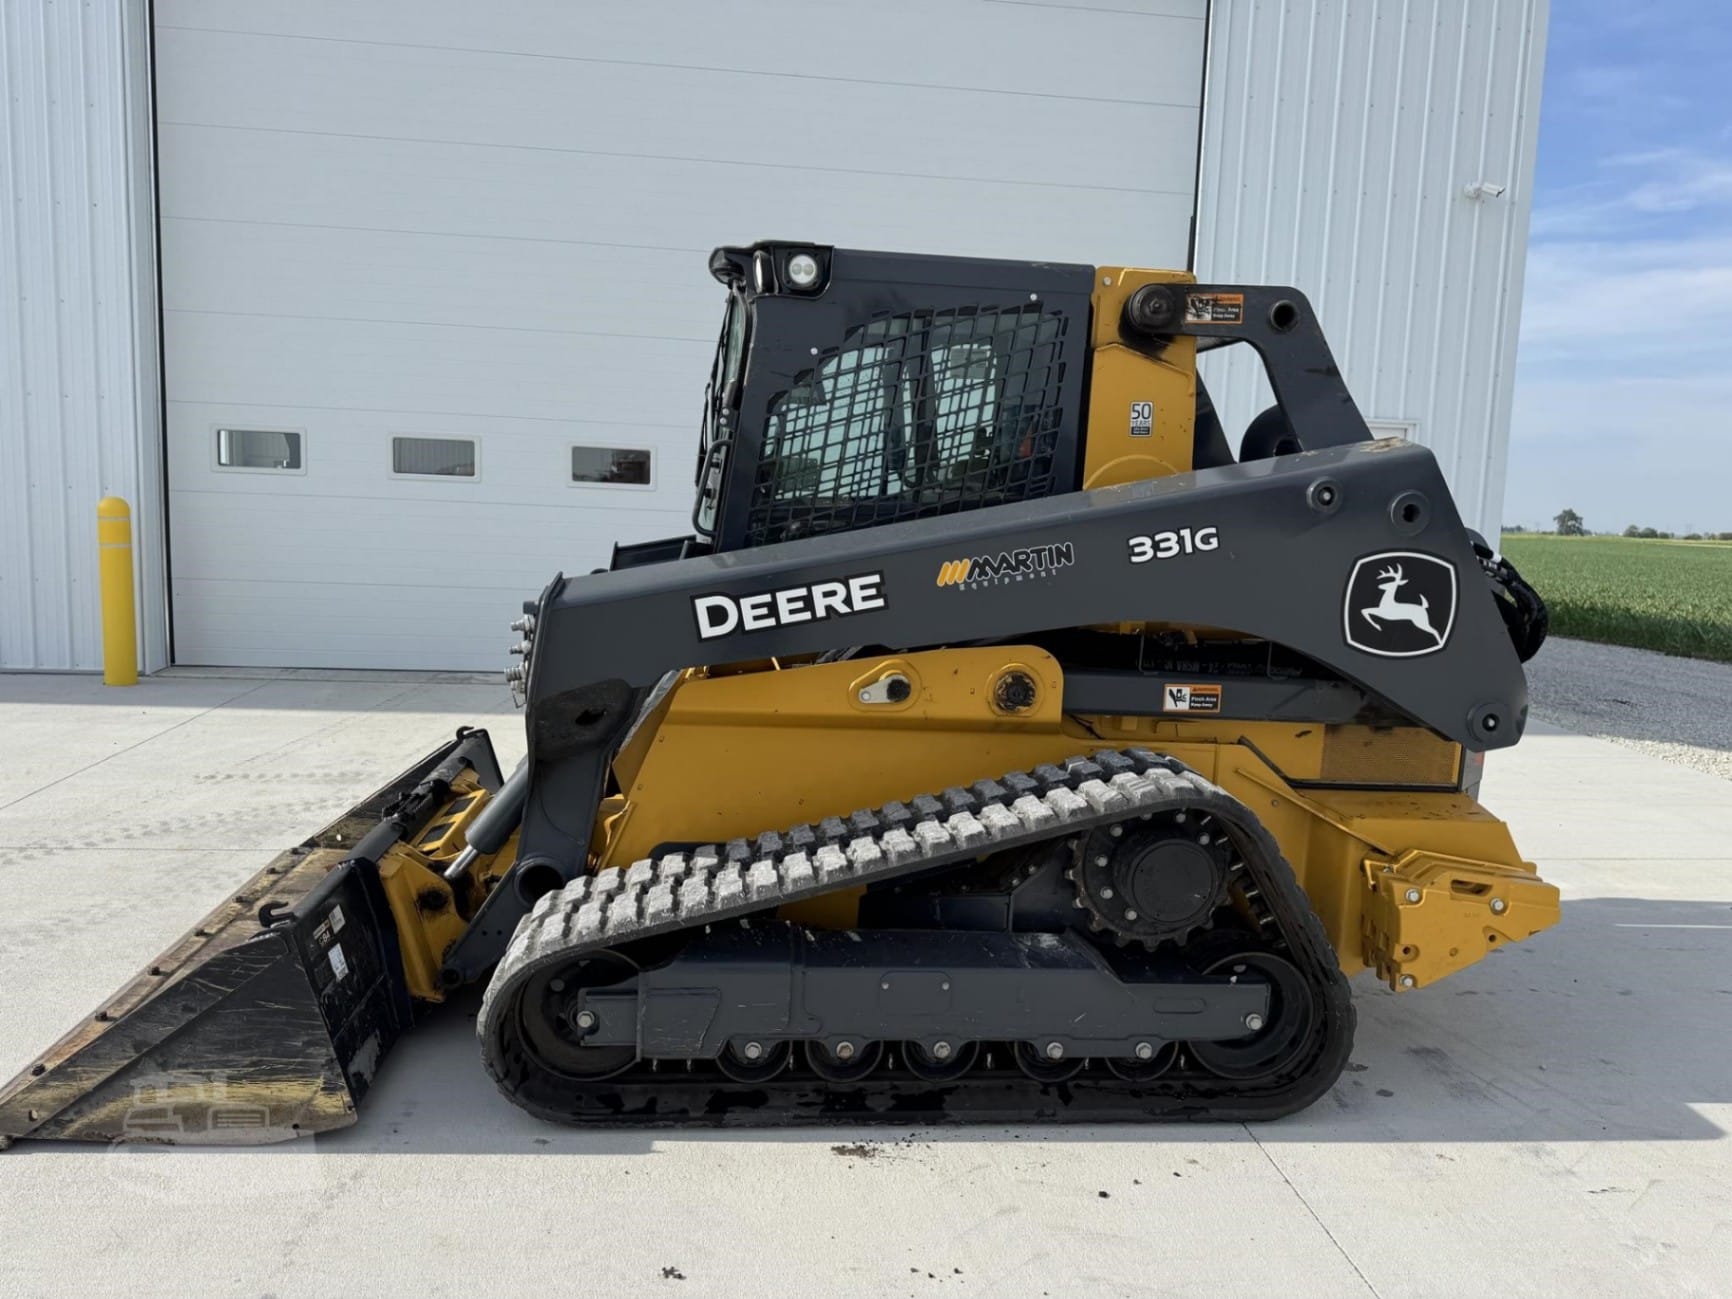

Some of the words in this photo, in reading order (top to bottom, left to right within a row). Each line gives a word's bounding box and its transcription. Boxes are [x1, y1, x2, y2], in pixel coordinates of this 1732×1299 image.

[1132, 403, 1152, 420] 50
[966, 542, 1075, 583] MARTIN
[1127, 527, 1219, 563] 331G
[694, 574, 885, 639] DEERE
